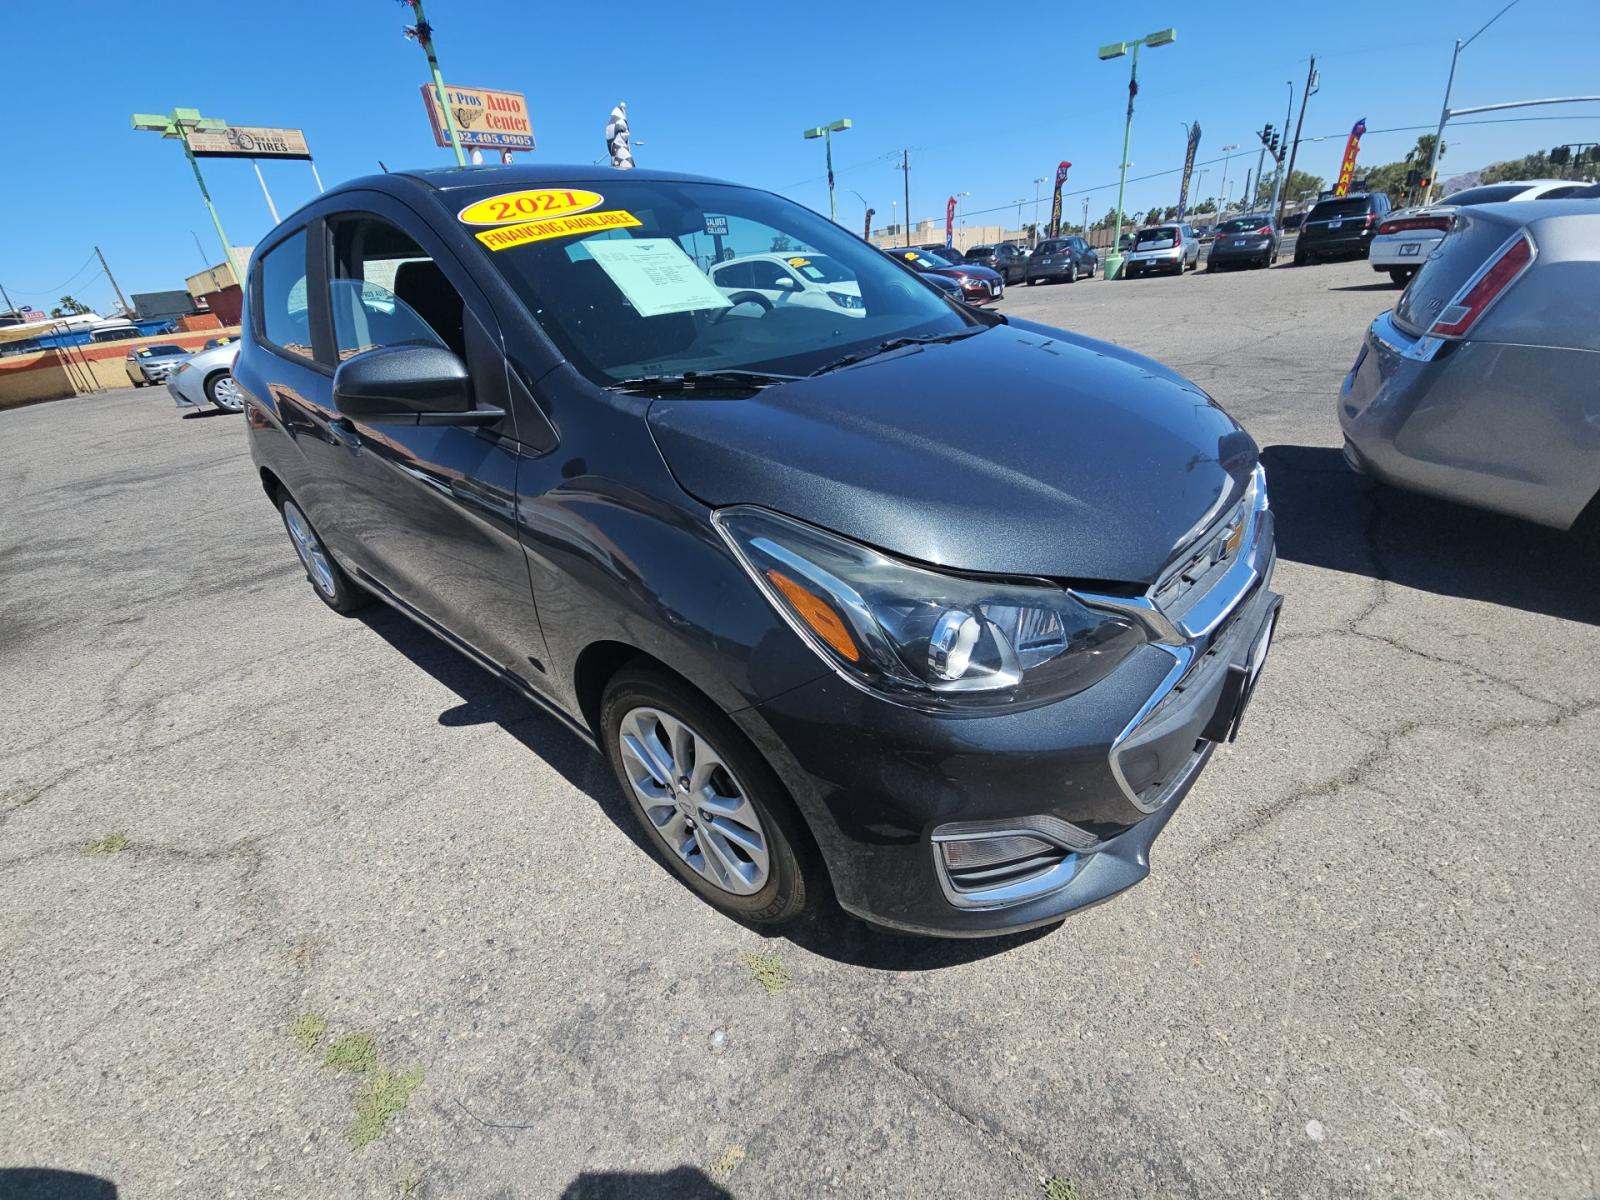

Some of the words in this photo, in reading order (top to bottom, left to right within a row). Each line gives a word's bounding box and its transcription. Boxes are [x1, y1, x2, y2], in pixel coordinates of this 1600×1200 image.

[455, 92, 482, 107] Pros
[486, 93, 521, 113] Auto
[485, 112, 528, 132] Center
[257, 143, 288, 152] TIRES
[489, 191, 582, 221] 2021
[484, 222, 564, 246] FINANCING
[565, 212, 634, 230] AVAILABLE
